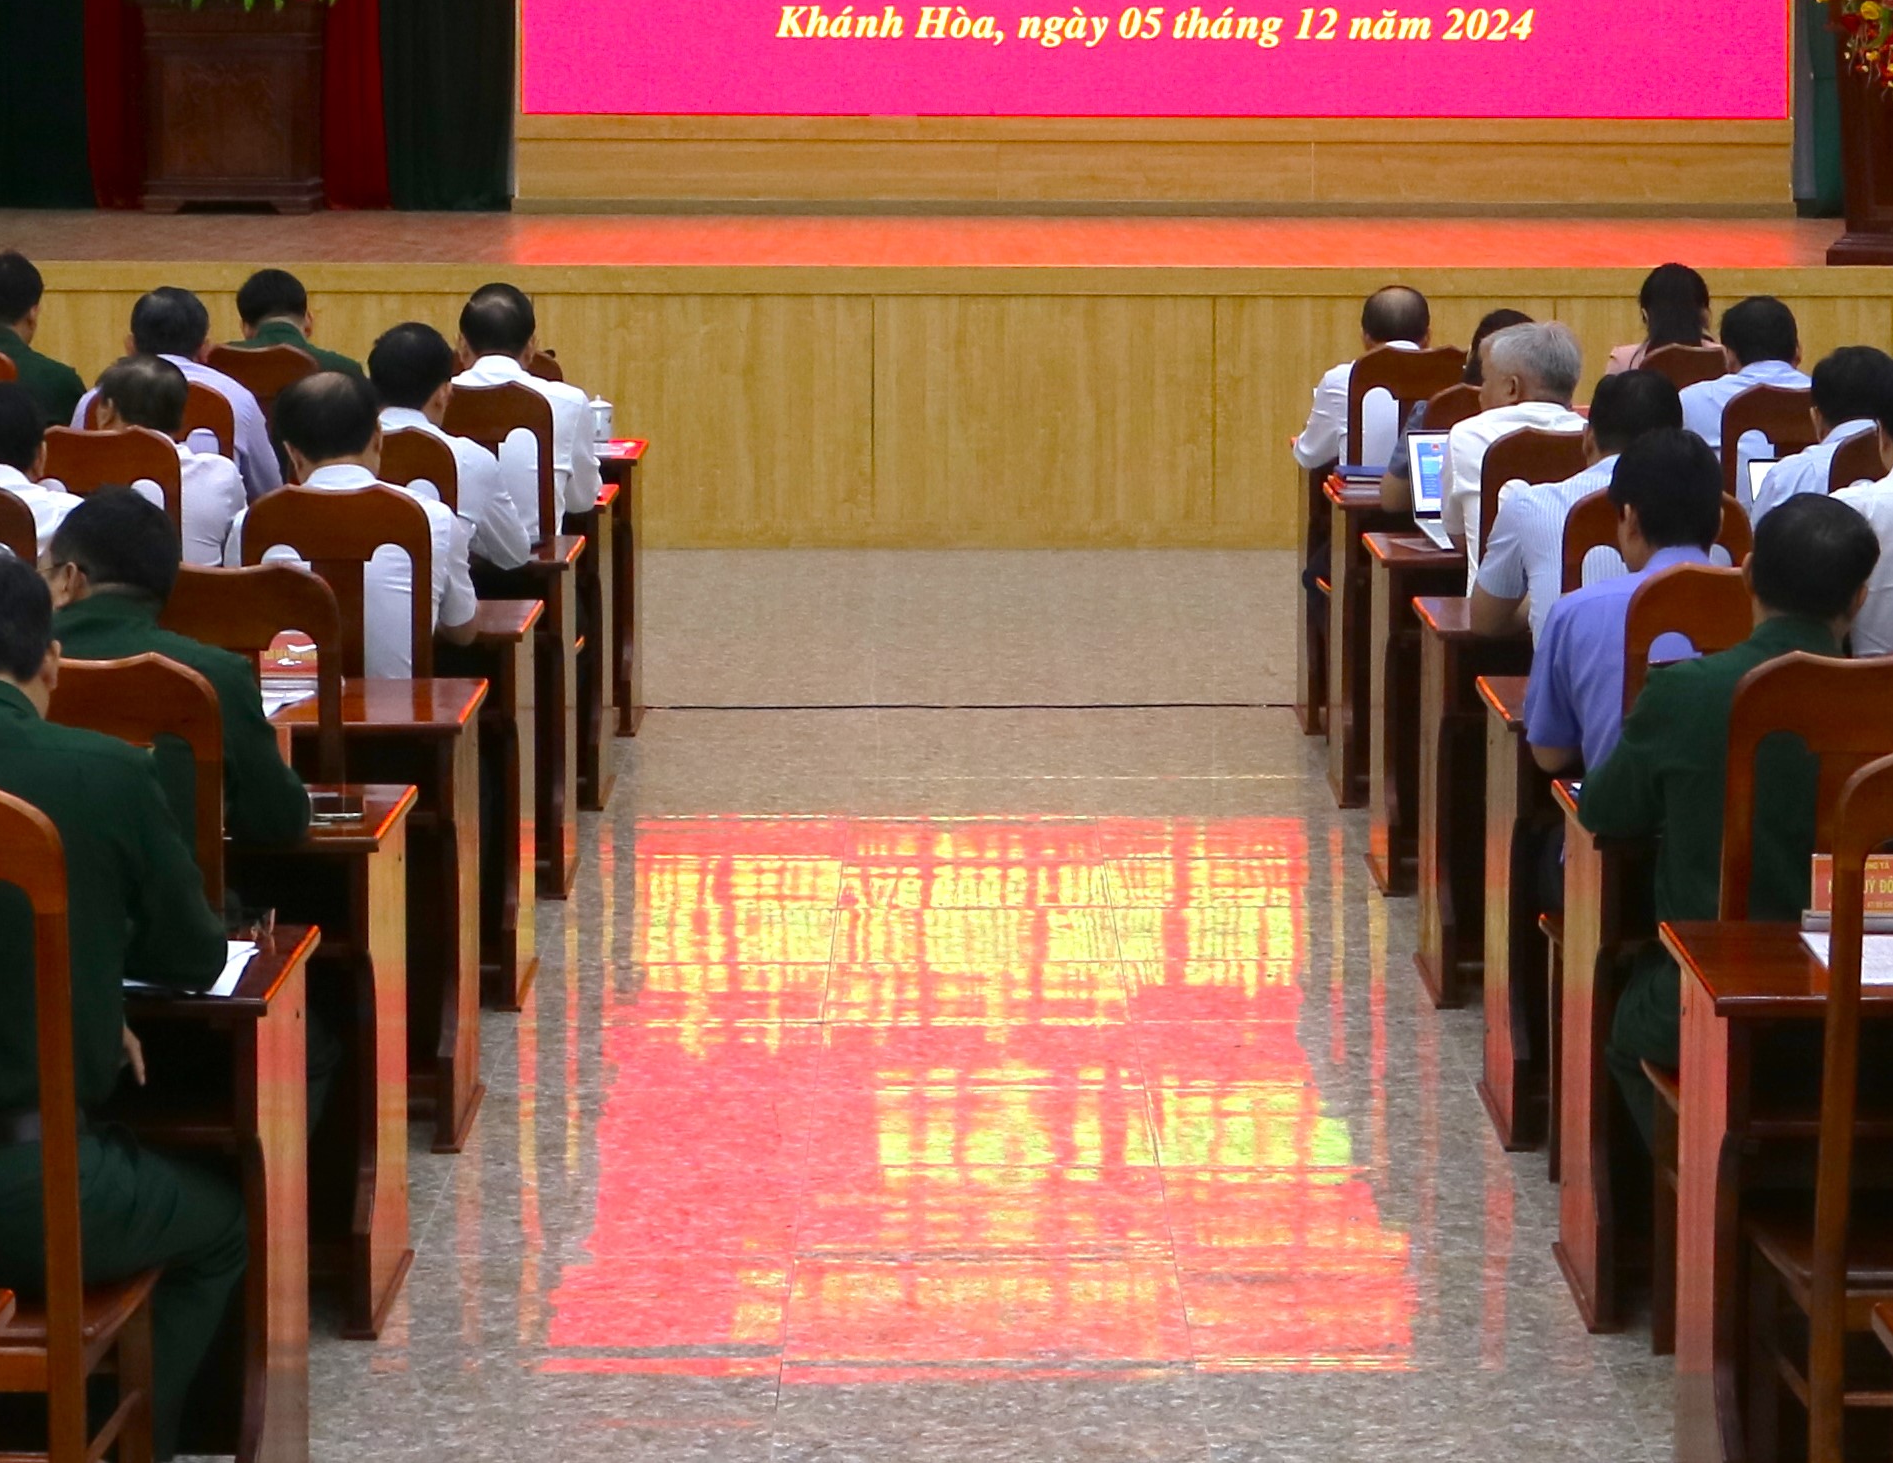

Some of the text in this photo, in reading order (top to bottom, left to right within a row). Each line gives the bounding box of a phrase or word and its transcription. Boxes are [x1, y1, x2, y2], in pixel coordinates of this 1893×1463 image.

[776, 6, 1533, 47] Khánh Hòa, ngày 05 tháng 12 năm 2024
